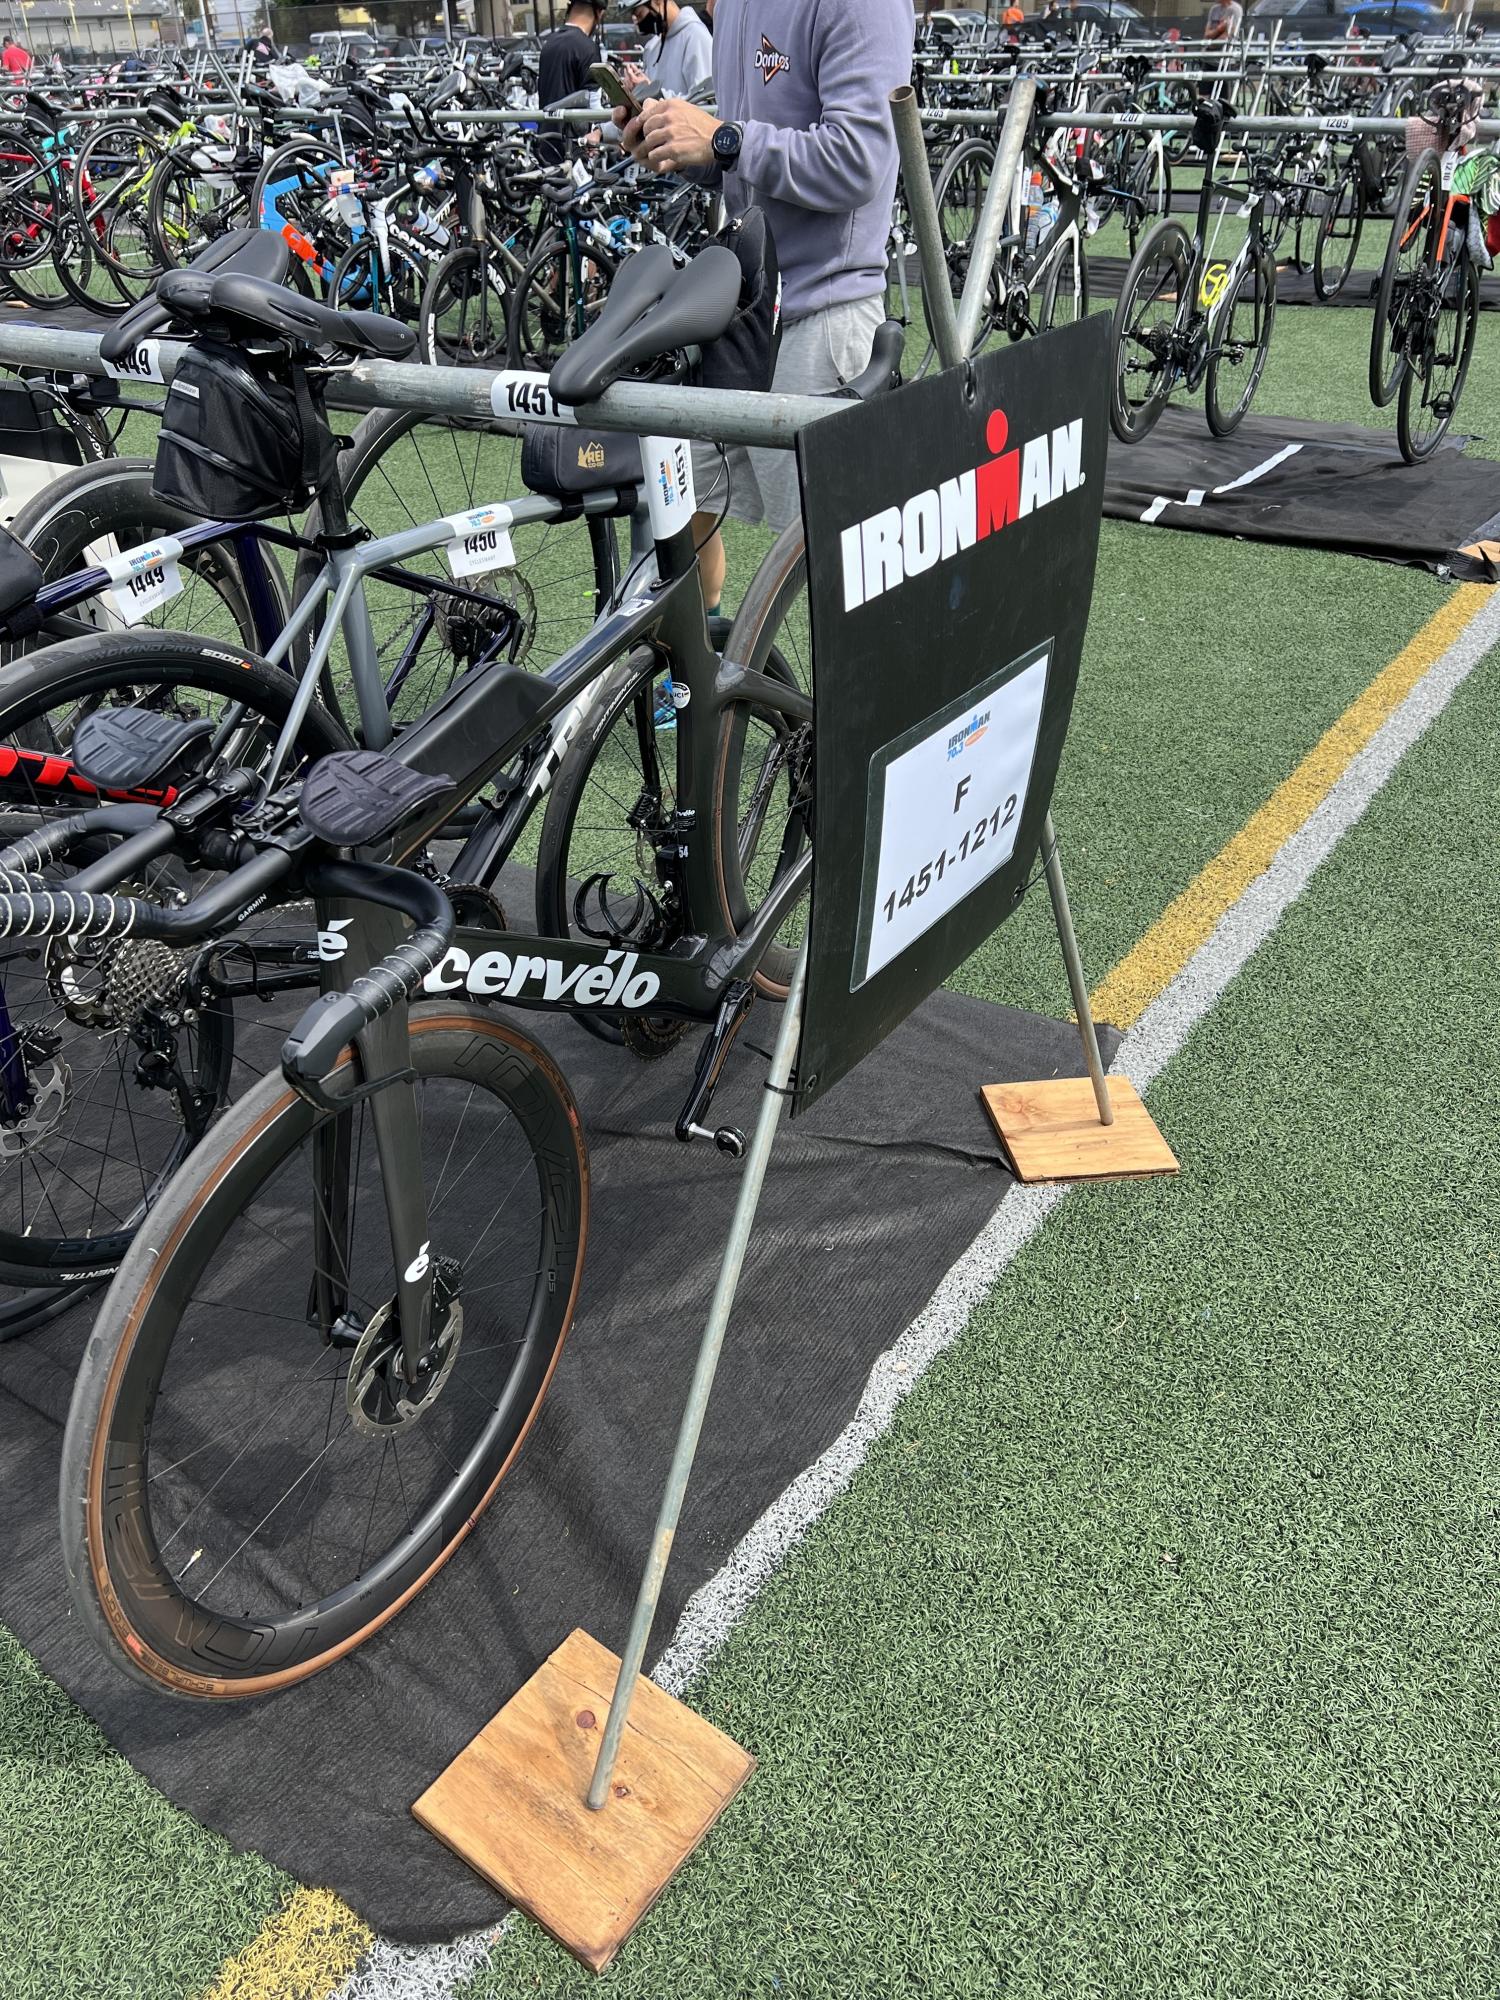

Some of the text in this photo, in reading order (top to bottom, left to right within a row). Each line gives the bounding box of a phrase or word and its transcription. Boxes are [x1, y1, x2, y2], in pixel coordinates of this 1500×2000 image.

[755, 50, 790, 71] Doritos
[1326, 118, 1349, 129] 1209
[588, 450, 604, 462] REI
[659, 461, 671, 507] IRONMAN
[675, 443, 687, 501] 1451
[841, 409, 1083, 613] IRONMAN
[464, 530, 497, 555] 1450
[129, 549, 162, 566] IRONMAN
[126, 566, 165, 598] 1449
[107, 643, 245, 666] GRAND PRIX 5000
[592, 672, 640, 741] CONTINENTAL
[948, 710, 991, 749] IRONMAN
[947, 742, 964, 762] 70.3
[953, 774, 971, 814] F
[678, 845, 689, 858] 54
[883, 793, 1017, 923] 1451-1212
[237, 893, 267, 922] GARMIN
[423, 946, 661, 1009] cervélo
[60, 1266, 120, 1281] NENTAL
